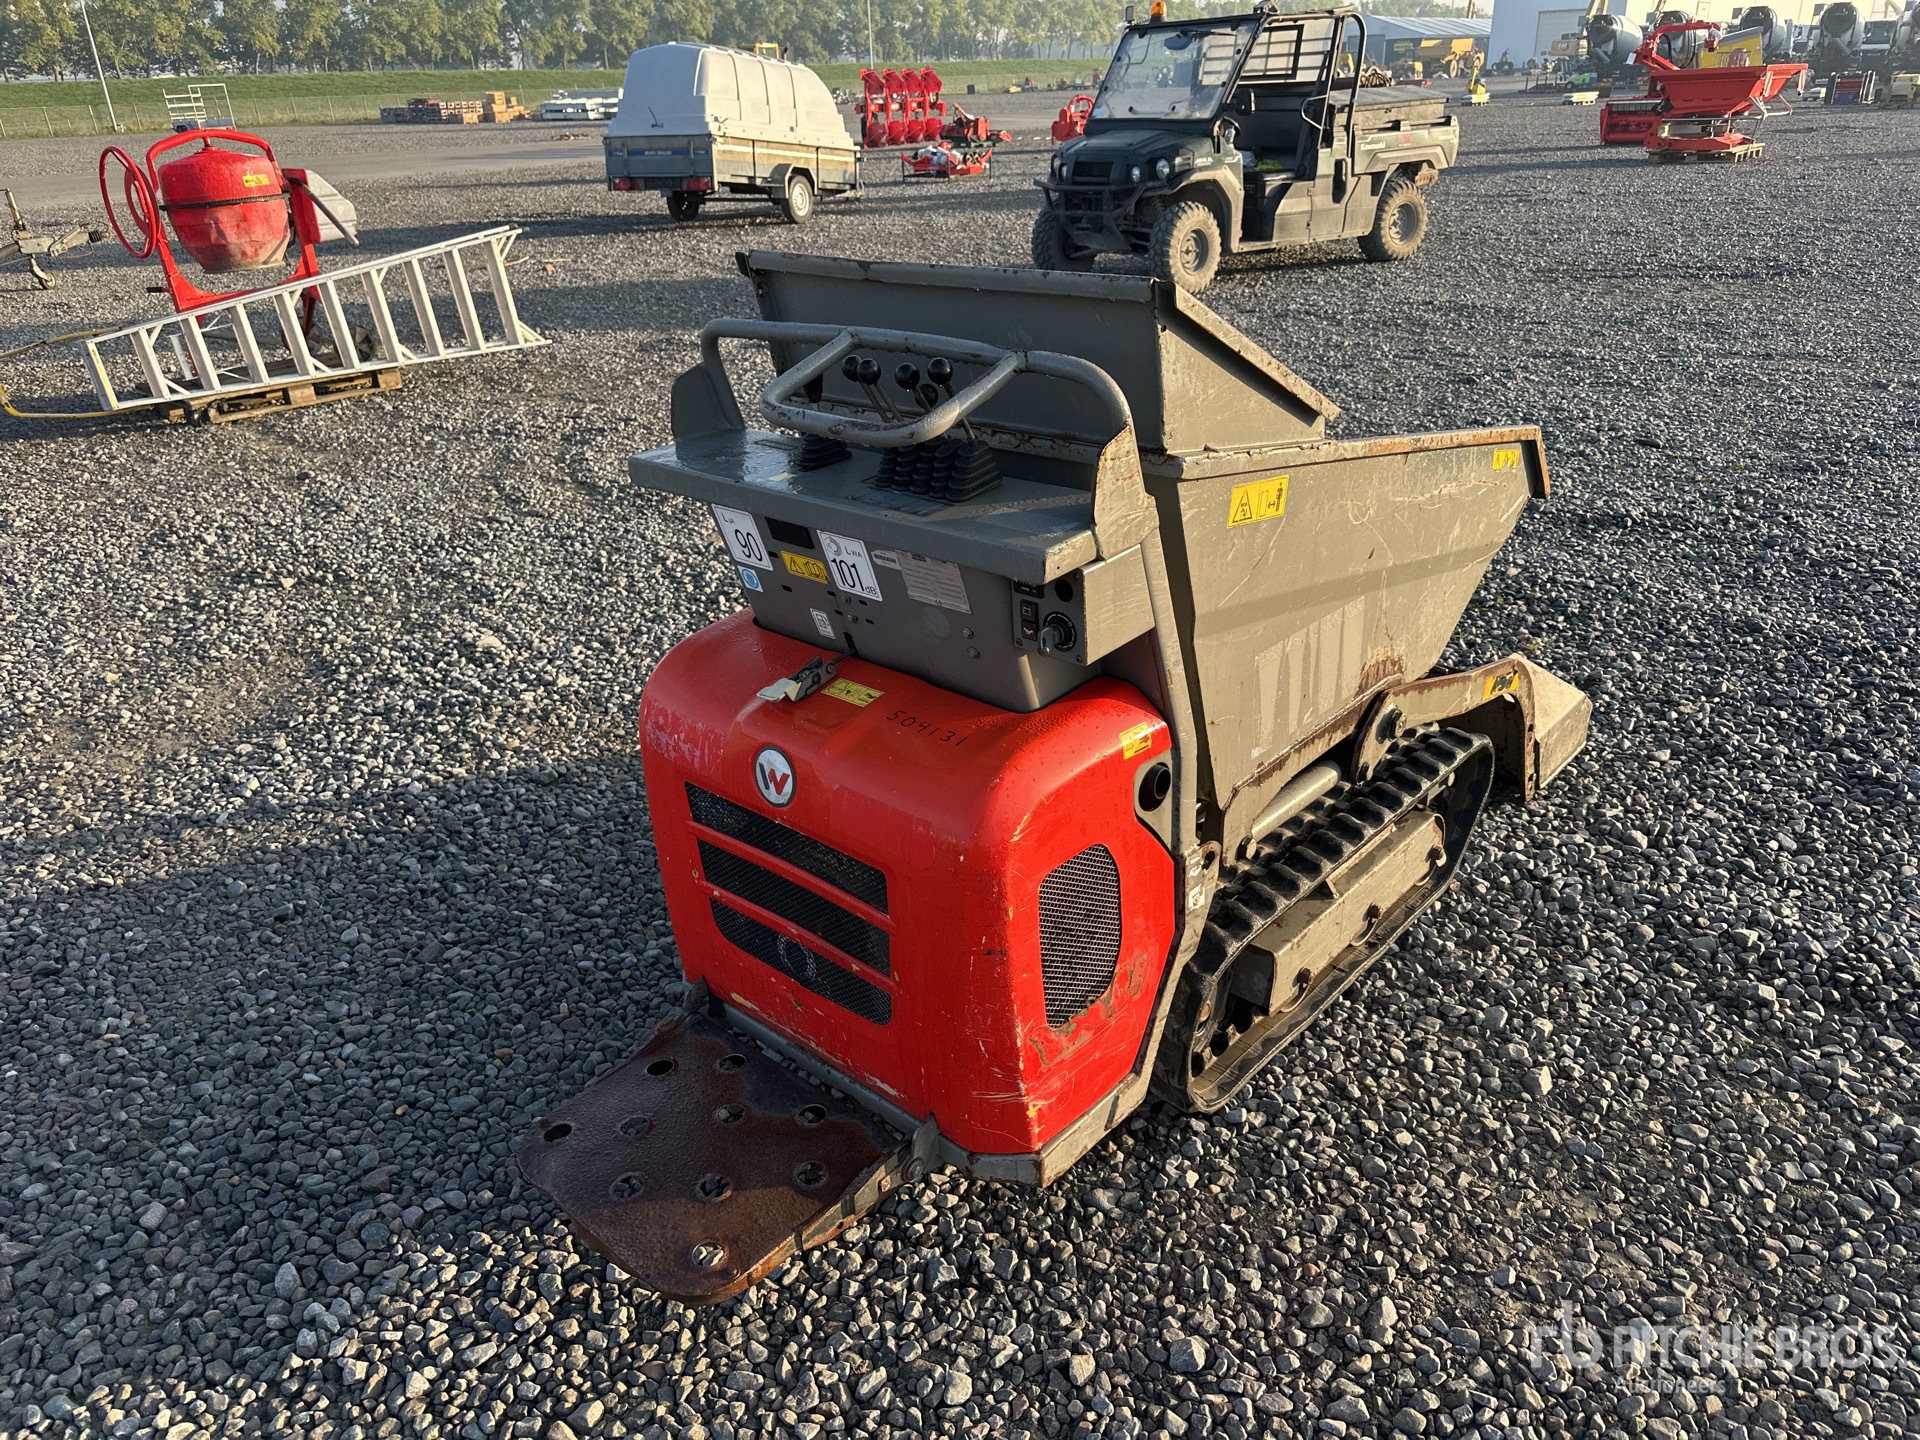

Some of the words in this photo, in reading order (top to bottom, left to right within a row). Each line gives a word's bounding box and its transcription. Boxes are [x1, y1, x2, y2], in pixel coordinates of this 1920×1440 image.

[734, 528, 763, 562] 90
[831, 557, 865, 592] 101
[886, 710, 968, 747] 504131
